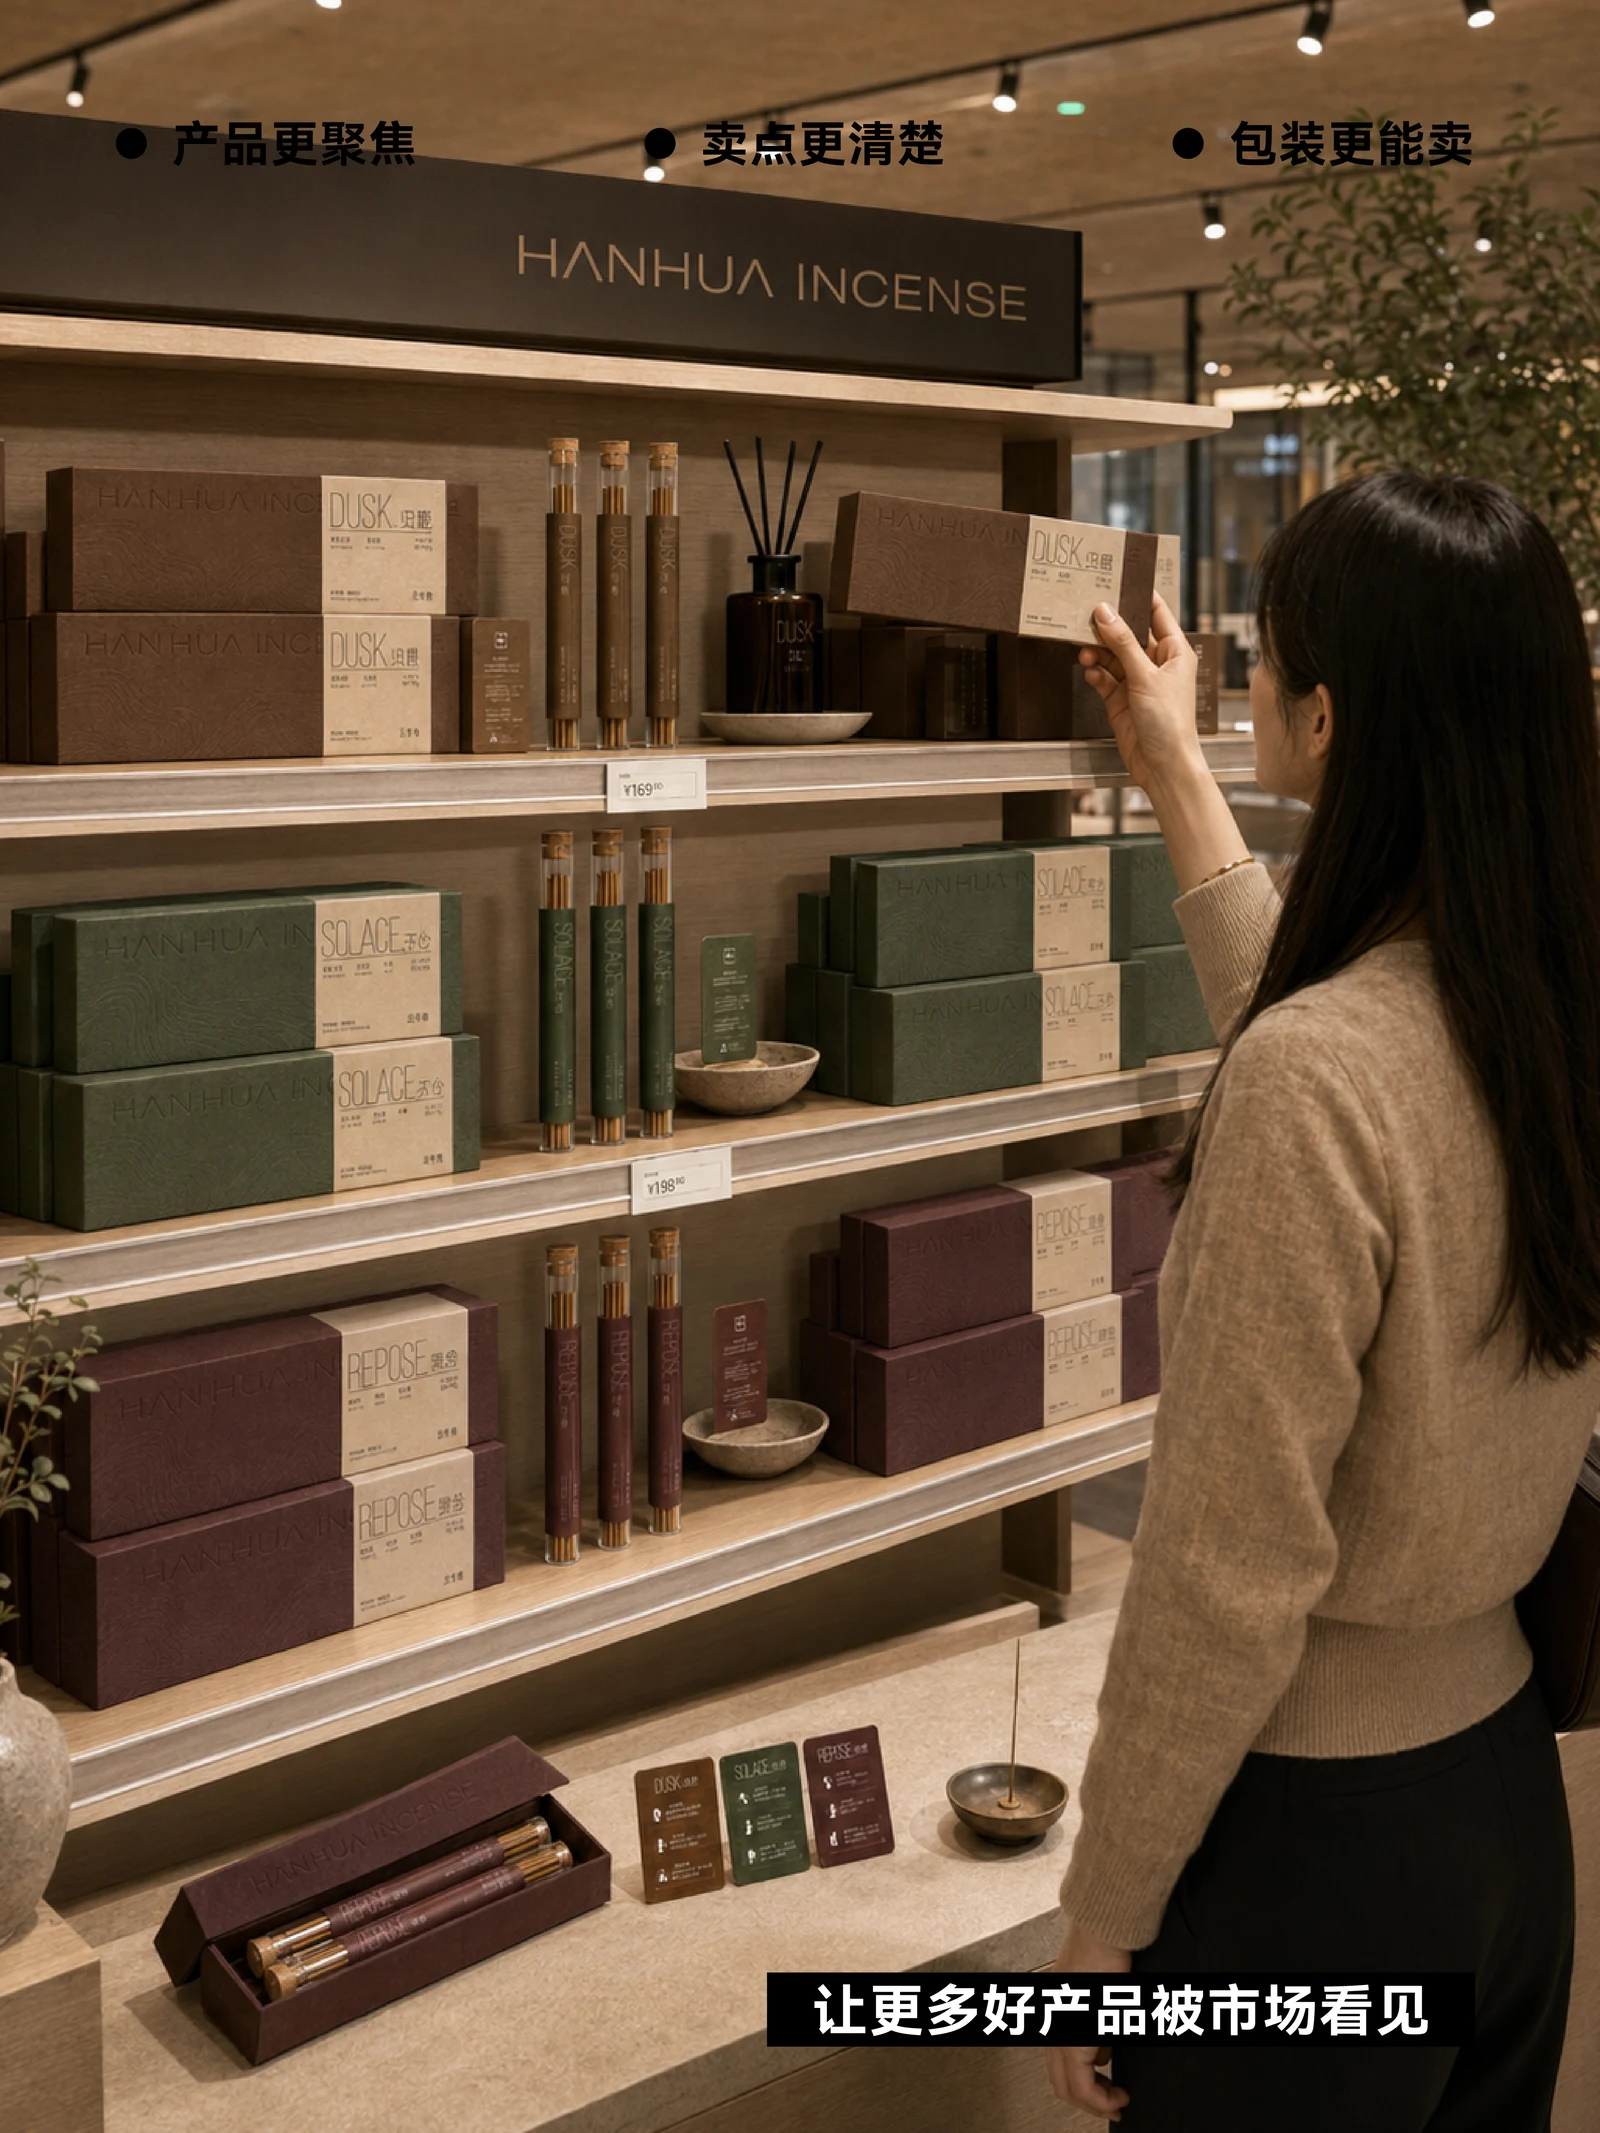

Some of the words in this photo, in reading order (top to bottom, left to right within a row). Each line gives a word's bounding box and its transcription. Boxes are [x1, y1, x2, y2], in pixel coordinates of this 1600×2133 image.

[518, 234, 774, 299] HANHUA
[798, 262, 1027, 322] INCENSE
[329, 492, 393, 529] DUSK
[1032, 530, 1084, 568] DUSK
[330, 632, 388, 668] DUSK
[321, 916, 402, 958] SOLACE
[338, 1064, 416, 1108] SOLACE
[348, 1338, 428, 1390] REPOSE
[359, 1484, 437, 1541] REPOSE
